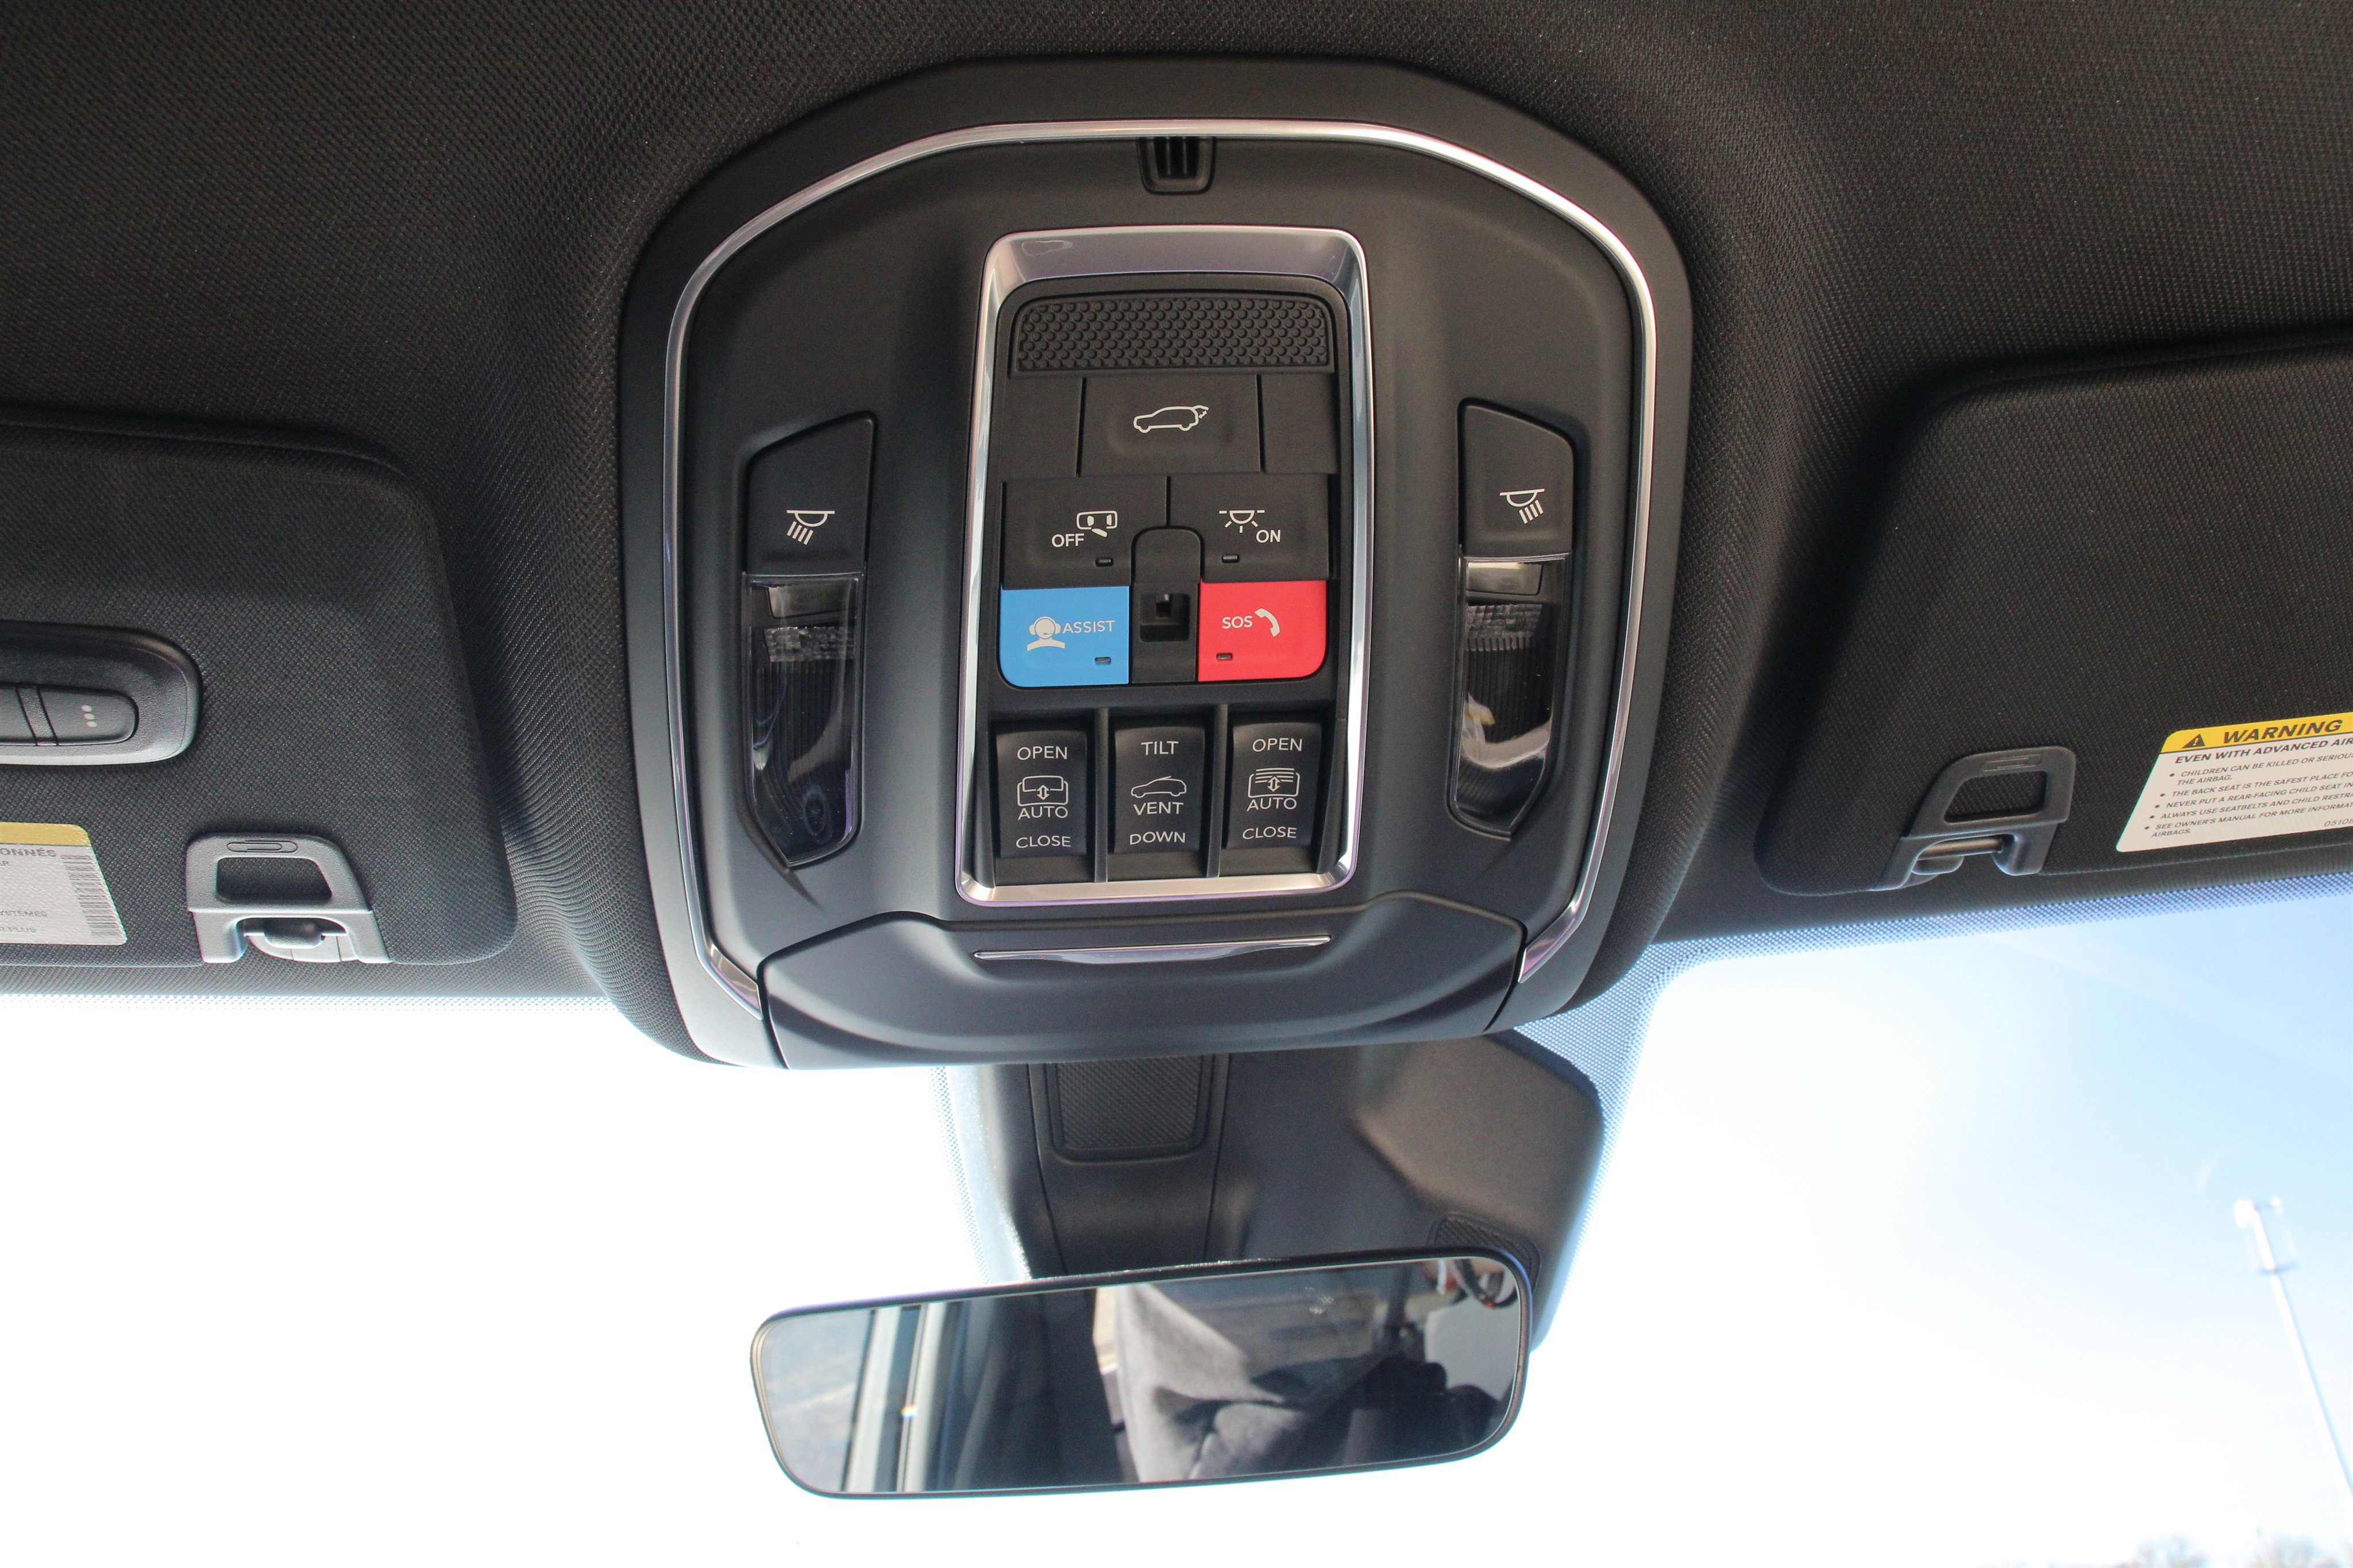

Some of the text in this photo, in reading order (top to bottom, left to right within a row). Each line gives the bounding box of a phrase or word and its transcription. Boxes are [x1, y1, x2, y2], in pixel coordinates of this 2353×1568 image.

[1051, 533, 1085, 547] OFF
[1256, 530, 1281, 543] ON
[1062, 620, 1115, 634] ASSIST
[1222, 615, 1253, 629] SOS
[2224, 720, 2343, 744] WARNING
[1141, 741, 1179, 755] TILT
[1252, 737, 1302, 752] OPEN
[2174, 753, 2212, 763] EVEN
[2215, 749, 2251, 759] WITH
[2252, 740, 2328, 755] ADVANCED
[1017, 746, 1067, 760] OPEN
[2181, 767, 2228, 777] CHILDREN
[2266, 759, 2298, 767] KILLED
[2192, 787, 2216, 795] BACK
[2274, 777, 2308, 786] SAFEST
[2309, 773, 2339, 781] PLACE
[2197, 775, 2232, 784] AIRBAG.
[2166, 800, 2197, 808] NEVER
[2227, 790, 2287, 801] REAR-FACING
[2289, 786, 2317, 794] CHILD
[1133, 801, 1184, 816] VENT
[1247, 797, 1297, 812] AUTO
[2161, 810, 2197, 819] ALWAYS
[2219, 802, 2267, 812] SEATBELTS
[2292, 796, 2320, 804] CHILD
[1018, 806, 1069, 820] AUTO
[2175, 818, 2216, 828] OWNER'S
[2218, 813, 2256, 822] MANUAL
[2279, 808, 2307, 816] MORE
[1129, 832, 1186, 845] DOWN
[1242, 826, 1297, 840] CLOSE
[2151, 829, 2192, 837] AIRBAGS.
[1016, 835, 1071, 848] CLOSE
